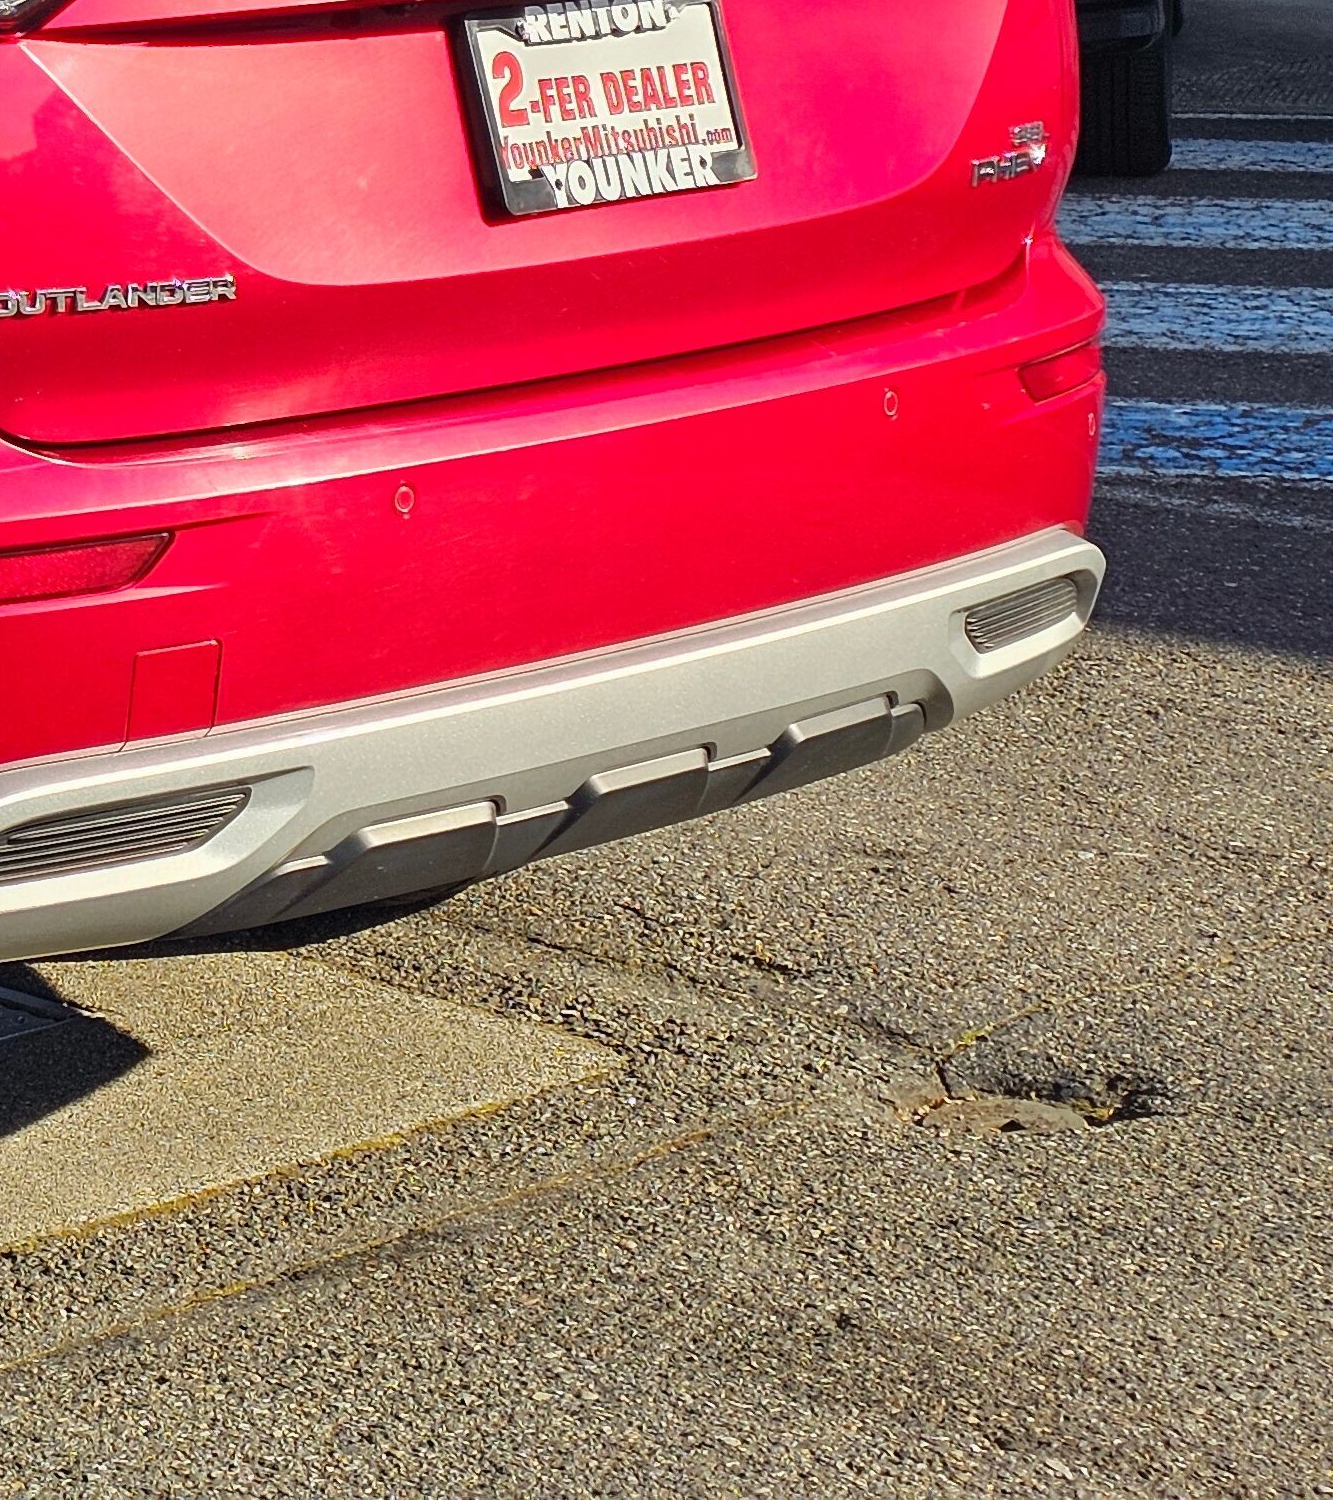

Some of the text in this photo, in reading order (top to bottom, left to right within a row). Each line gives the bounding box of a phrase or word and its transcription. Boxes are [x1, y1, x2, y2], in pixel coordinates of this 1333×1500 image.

[491, 50, 715, 128] 2-FER DEALER
[539, 144, 723, 209] YOUNKER
